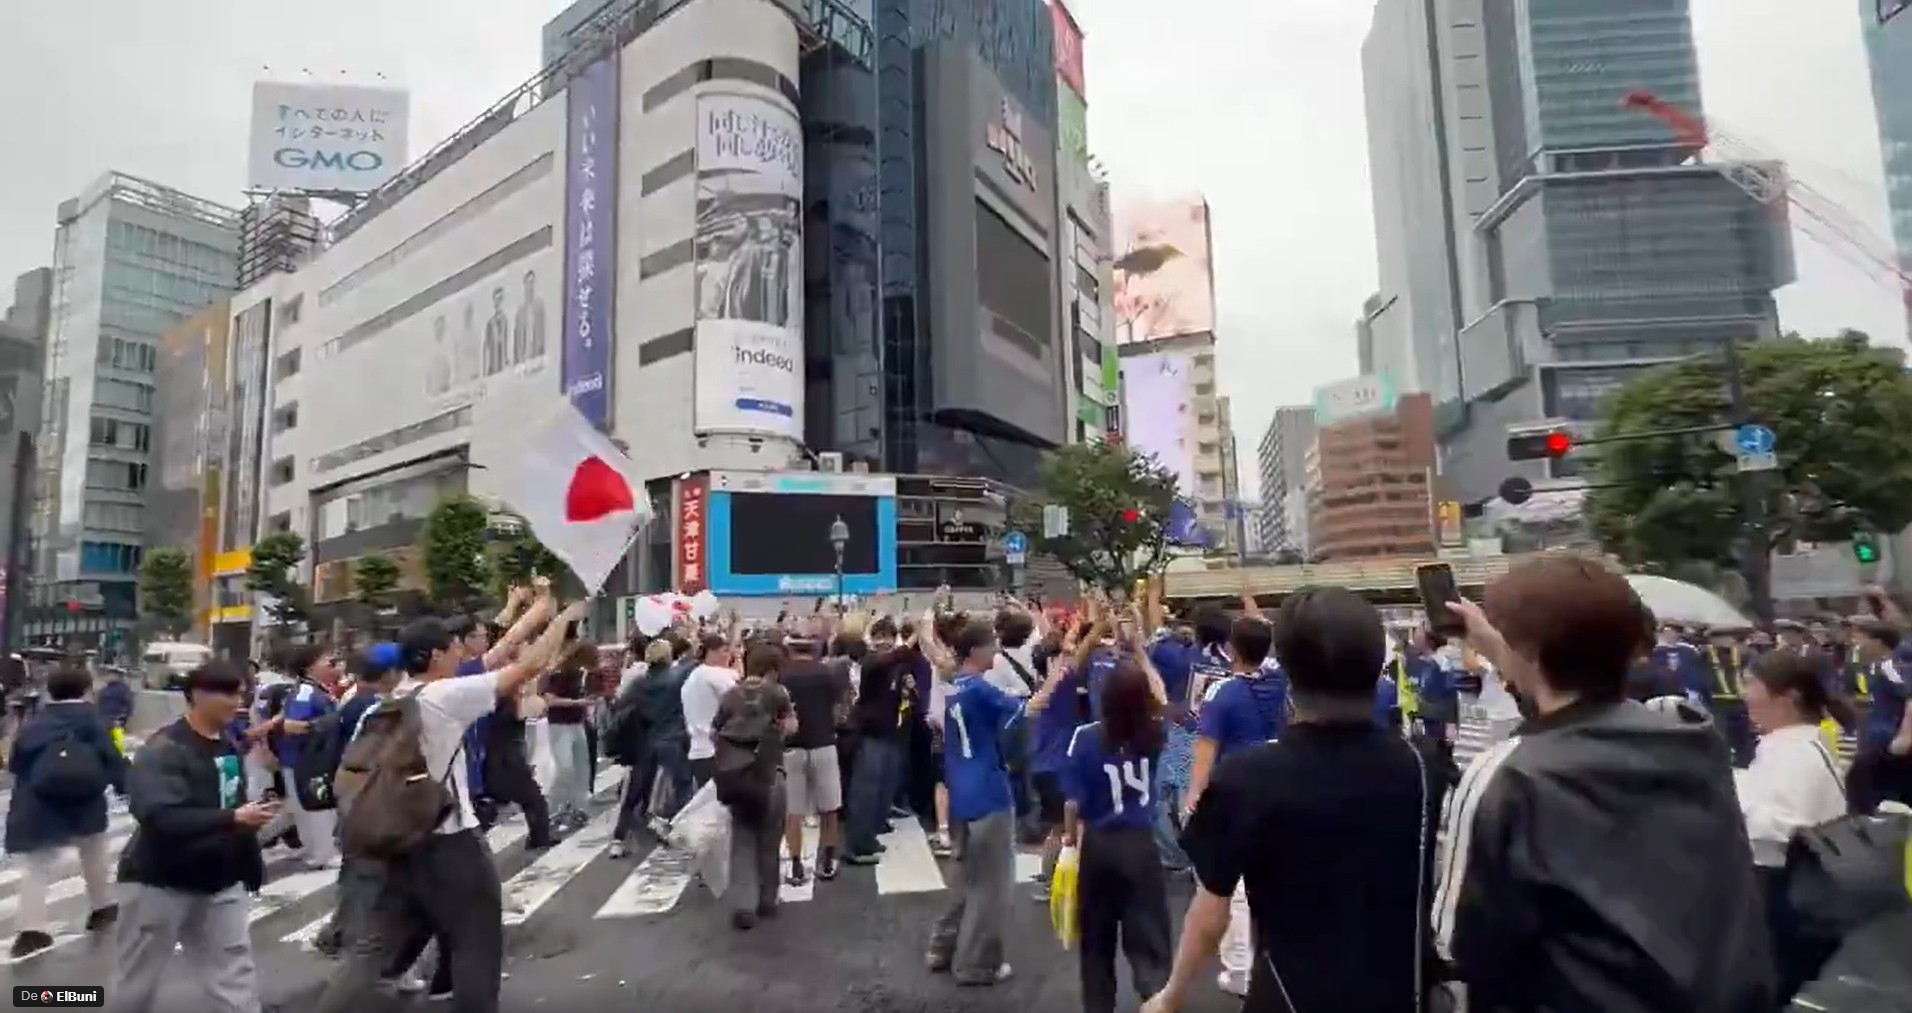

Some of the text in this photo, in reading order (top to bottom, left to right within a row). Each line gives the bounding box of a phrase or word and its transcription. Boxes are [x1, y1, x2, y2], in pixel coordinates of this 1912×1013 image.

[278, 104, 389, 124] すべての人に
[275, 125, 385, 142] インターネット
[274, 147, 383, 171] GMO
[735, 345, 794, 373] indeed
[950, 702, 973, 759] 1
[1103, 757, 1150, 814] 14
